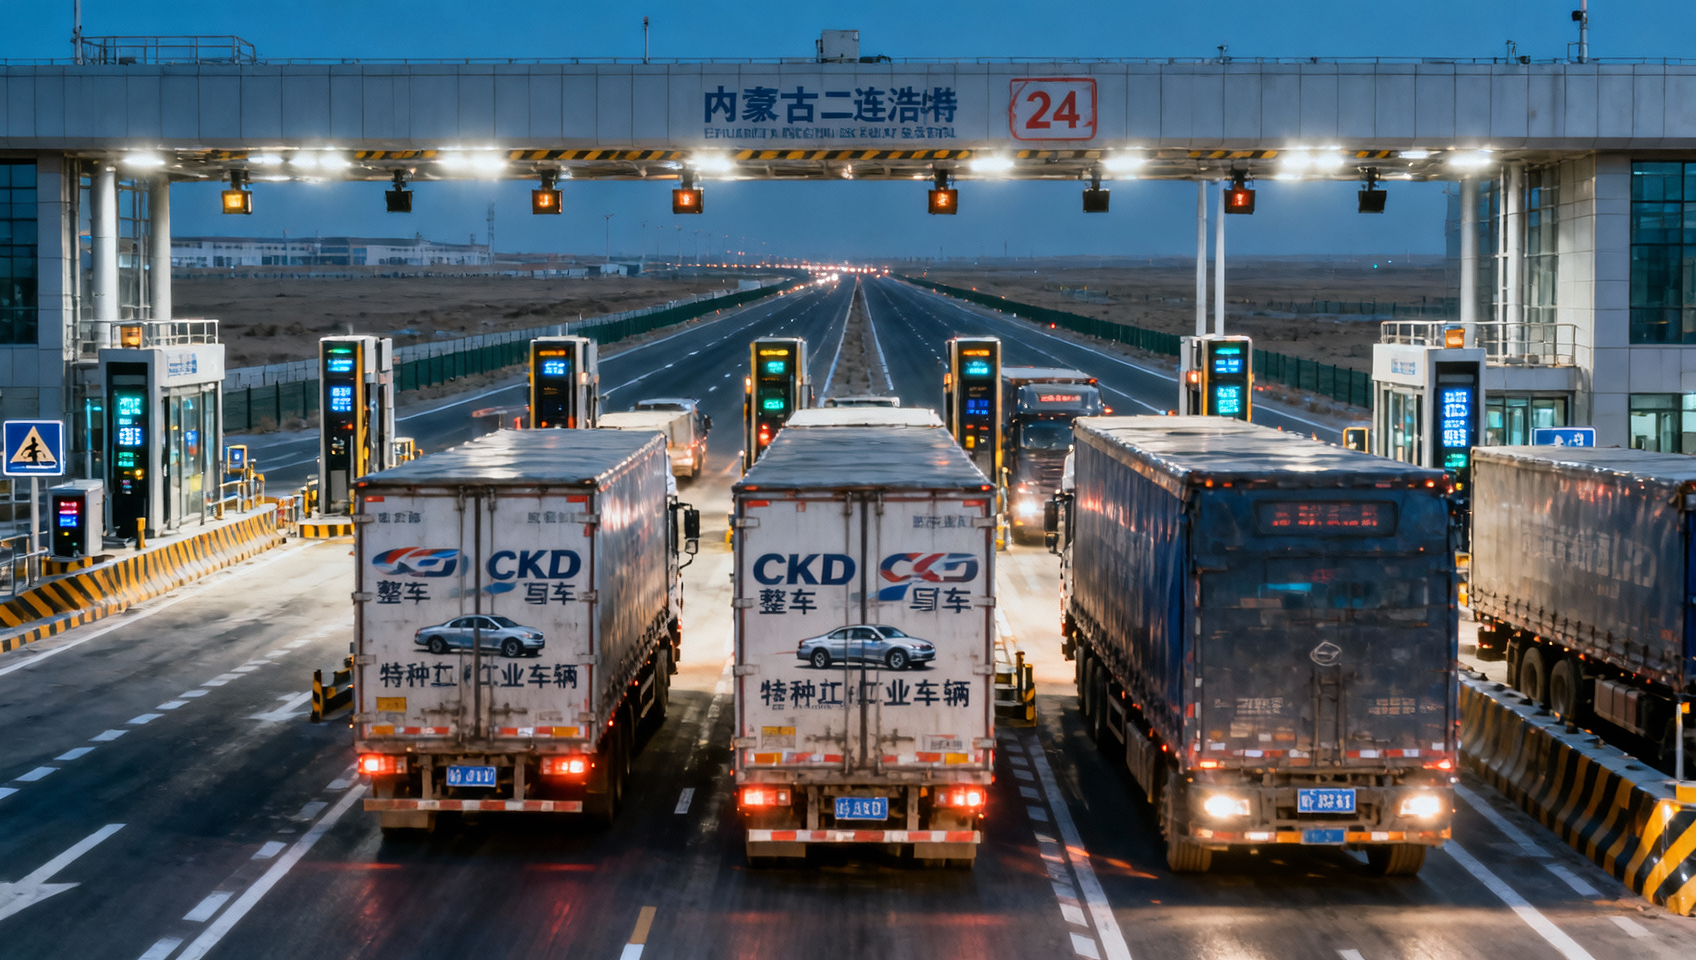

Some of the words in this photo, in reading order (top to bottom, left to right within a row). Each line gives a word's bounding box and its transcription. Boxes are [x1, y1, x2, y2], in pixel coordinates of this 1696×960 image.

[1025, 91, 1081, 129] 24
[488, 549, 581, 580] CKD
[753, 553, 856, 585] CKD
